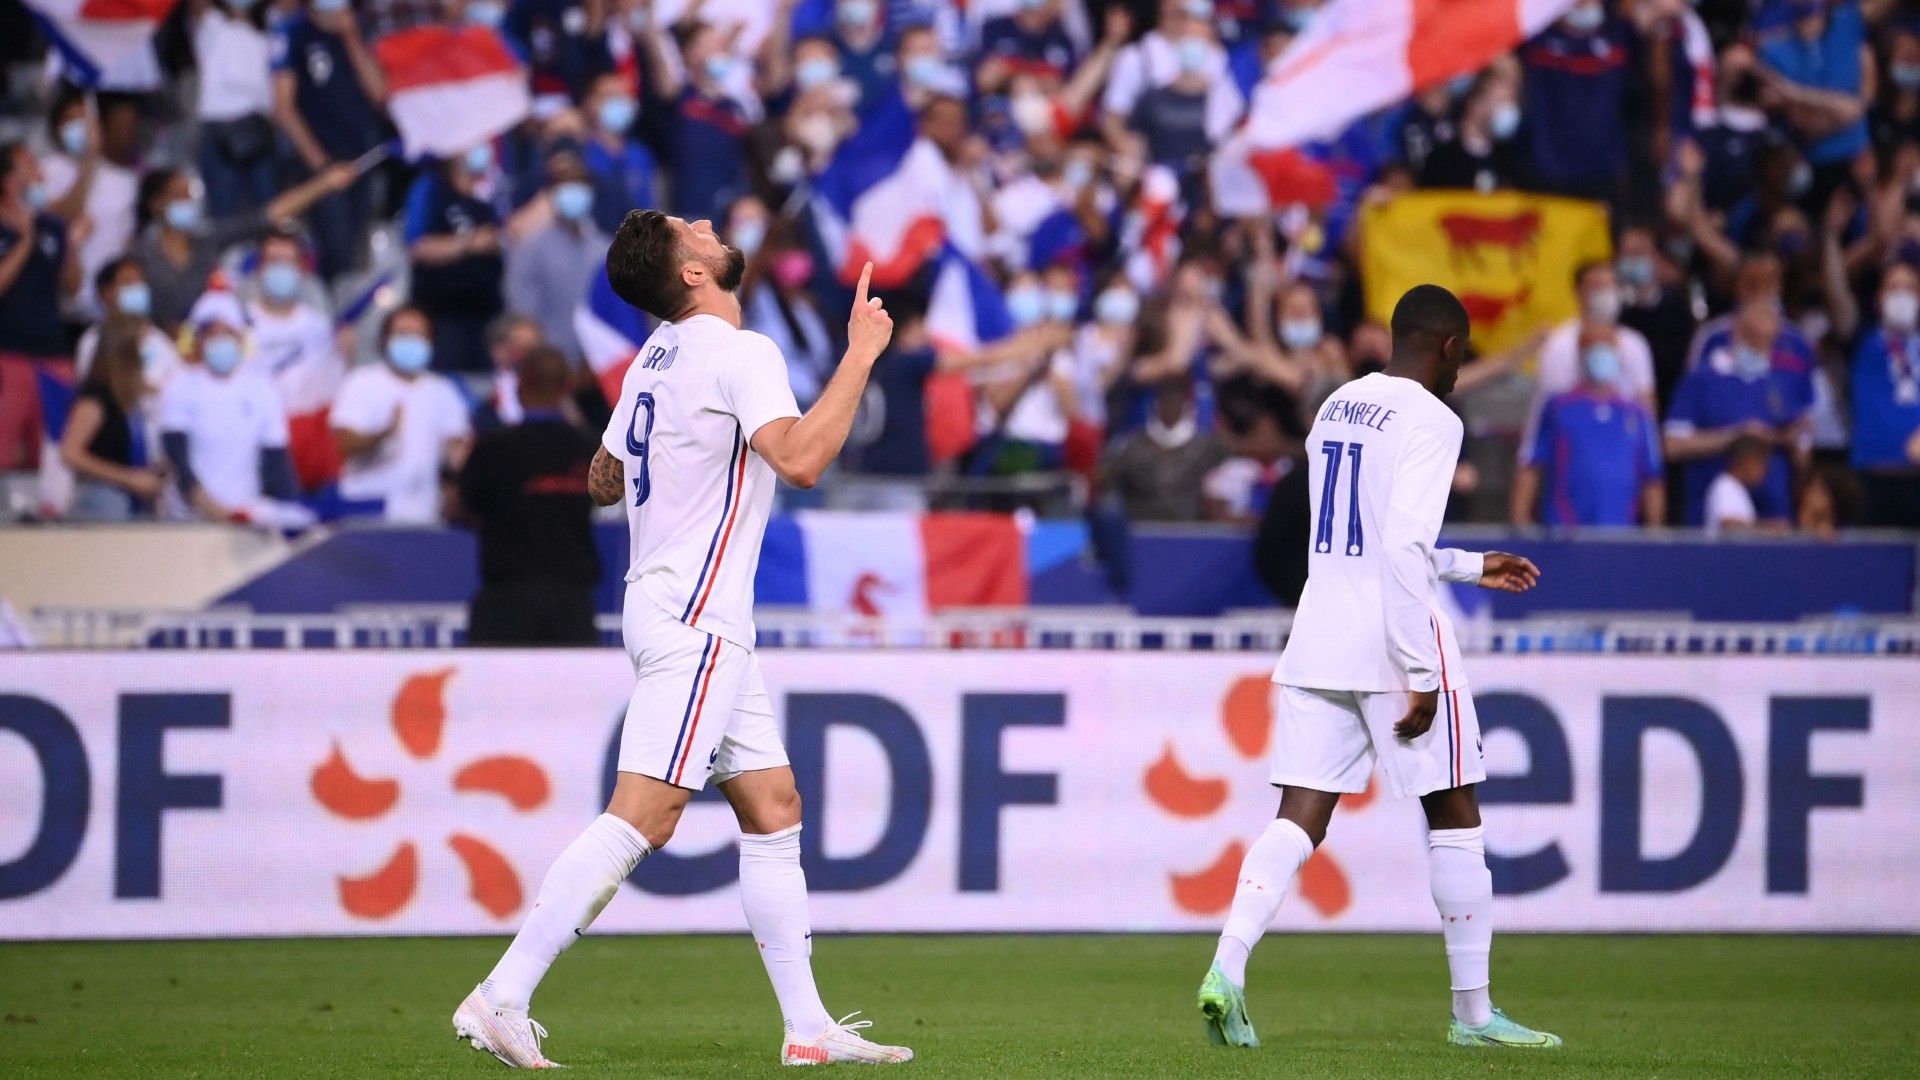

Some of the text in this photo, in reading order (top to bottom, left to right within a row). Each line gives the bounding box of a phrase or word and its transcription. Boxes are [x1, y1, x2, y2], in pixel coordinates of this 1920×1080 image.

[626, 392, 655, 507] 9
[1320, 400, 1397, 432] DEMBELE
[1315, 440, 1363, 557] 11
[1474, 690, 1871, 896] eDF
